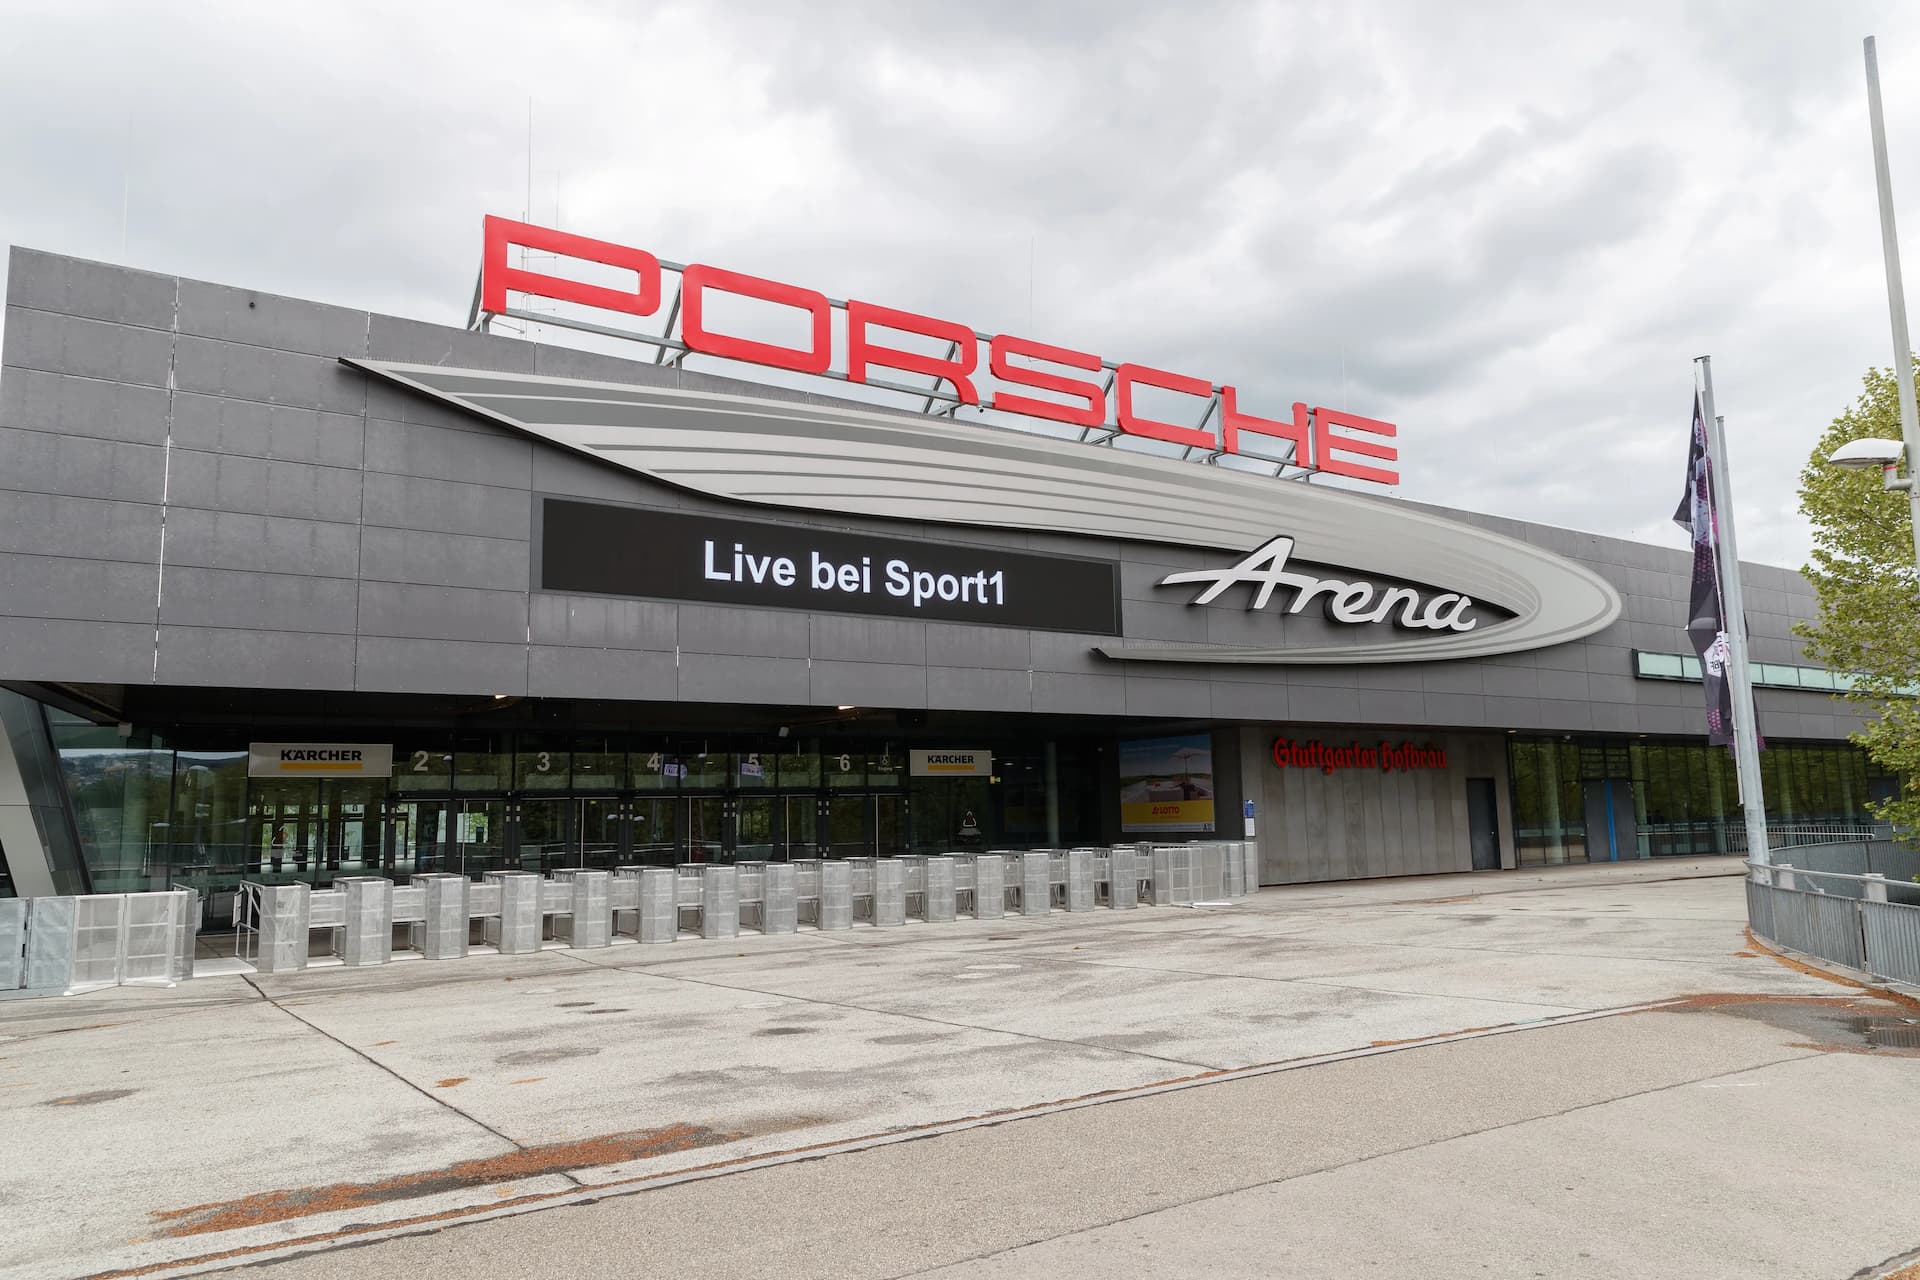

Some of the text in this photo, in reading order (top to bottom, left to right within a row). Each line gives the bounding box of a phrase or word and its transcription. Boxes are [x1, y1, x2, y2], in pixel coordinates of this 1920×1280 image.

[482, 214, 1400, 485] PORSCHE
[704, 540, 1004, 607] Live bei Sport1
[1158, 535, 1477, 632] Arena
[280, 749, 363, 761] KÄRCHER
[413, 750, 430, 772] 2
[536, 751, 551, 772] 3
[646, 752, 661, 772] 4
[747, 753, 760, 770] 5
[839, 753, 850, 772] 6
[927, 754, 975, 764] KÄRCHER
[1273, 737, 1377, 774] Stuttgarter
[1159, 805, 1180, 815] LOTTO
